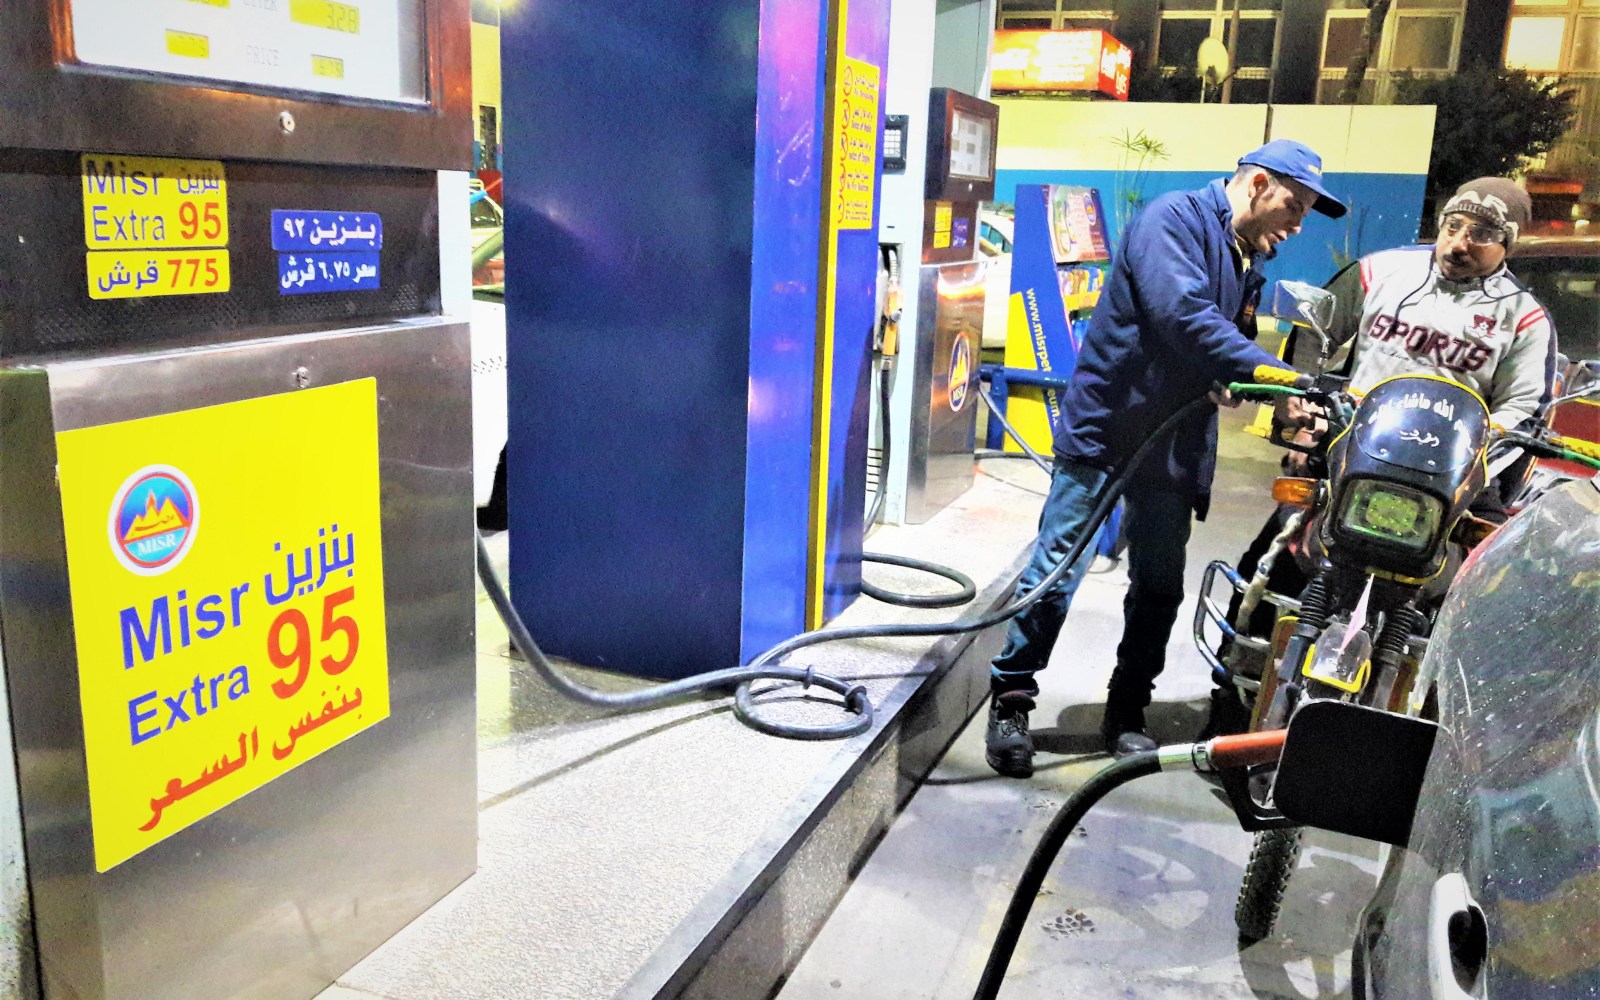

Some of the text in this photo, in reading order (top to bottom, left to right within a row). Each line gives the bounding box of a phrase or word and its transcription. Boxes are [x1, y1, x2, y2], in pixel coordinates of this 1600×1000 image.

[247, 45, 279, 67] PRICE
[86, 160, 219, 195] Misr بنزين
[92, 201, 222, 241] Extra 95
[283, 215, 376, 246] بنزين ٩٢
[98, 258, 219, 292] 775 قرش
[281, 255, 316, 289] قرش
[352, 263, 377, 284] سعر
[1369, 312, 1493, 373] SPORTS
[137, 533, 178, 557] MISR
[119, 523, 355, 670] Misr بنزين
[128, 585, 360, 746] Extra 95
[137, 684, 363, 832] بنفس السعر
